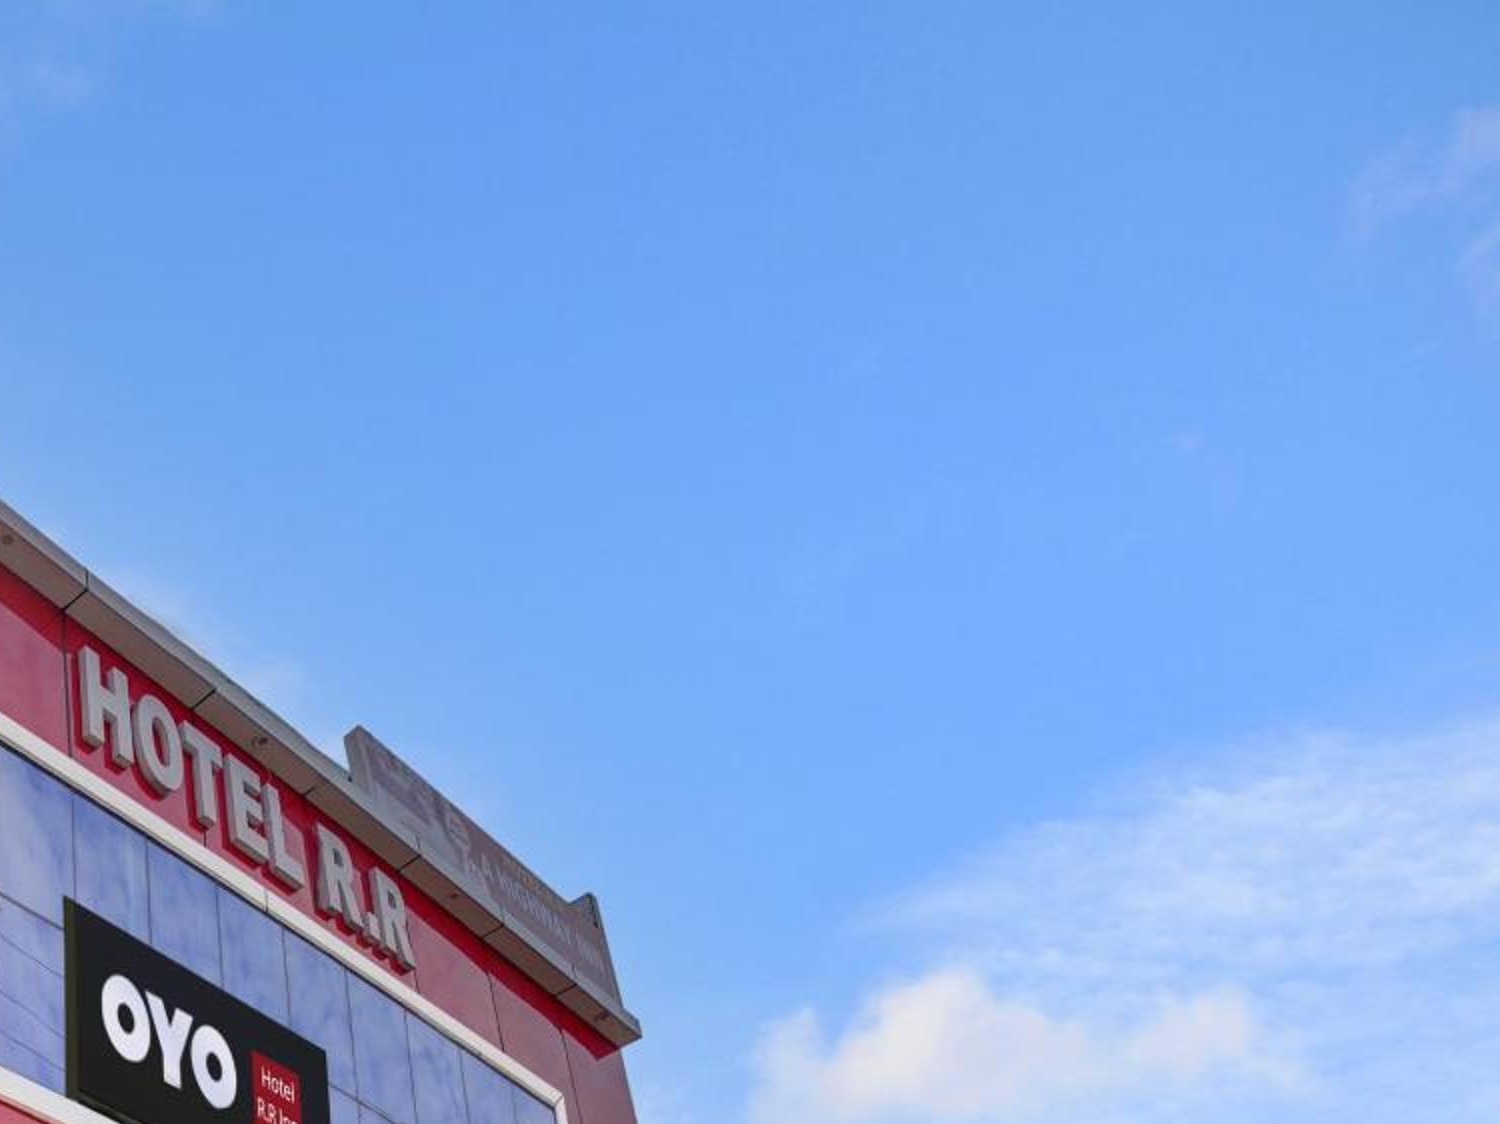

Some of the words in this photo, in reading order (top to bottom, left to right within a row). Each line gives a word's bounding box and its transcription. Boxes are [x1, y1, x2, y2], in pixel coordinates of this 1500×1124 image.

[78, 646, 303, 890] HOTEL
[316, 823, 415, 969] R.R
[101, 974, 237, 1110] OYO
[261, 1065, 295, 1104] Hotel
